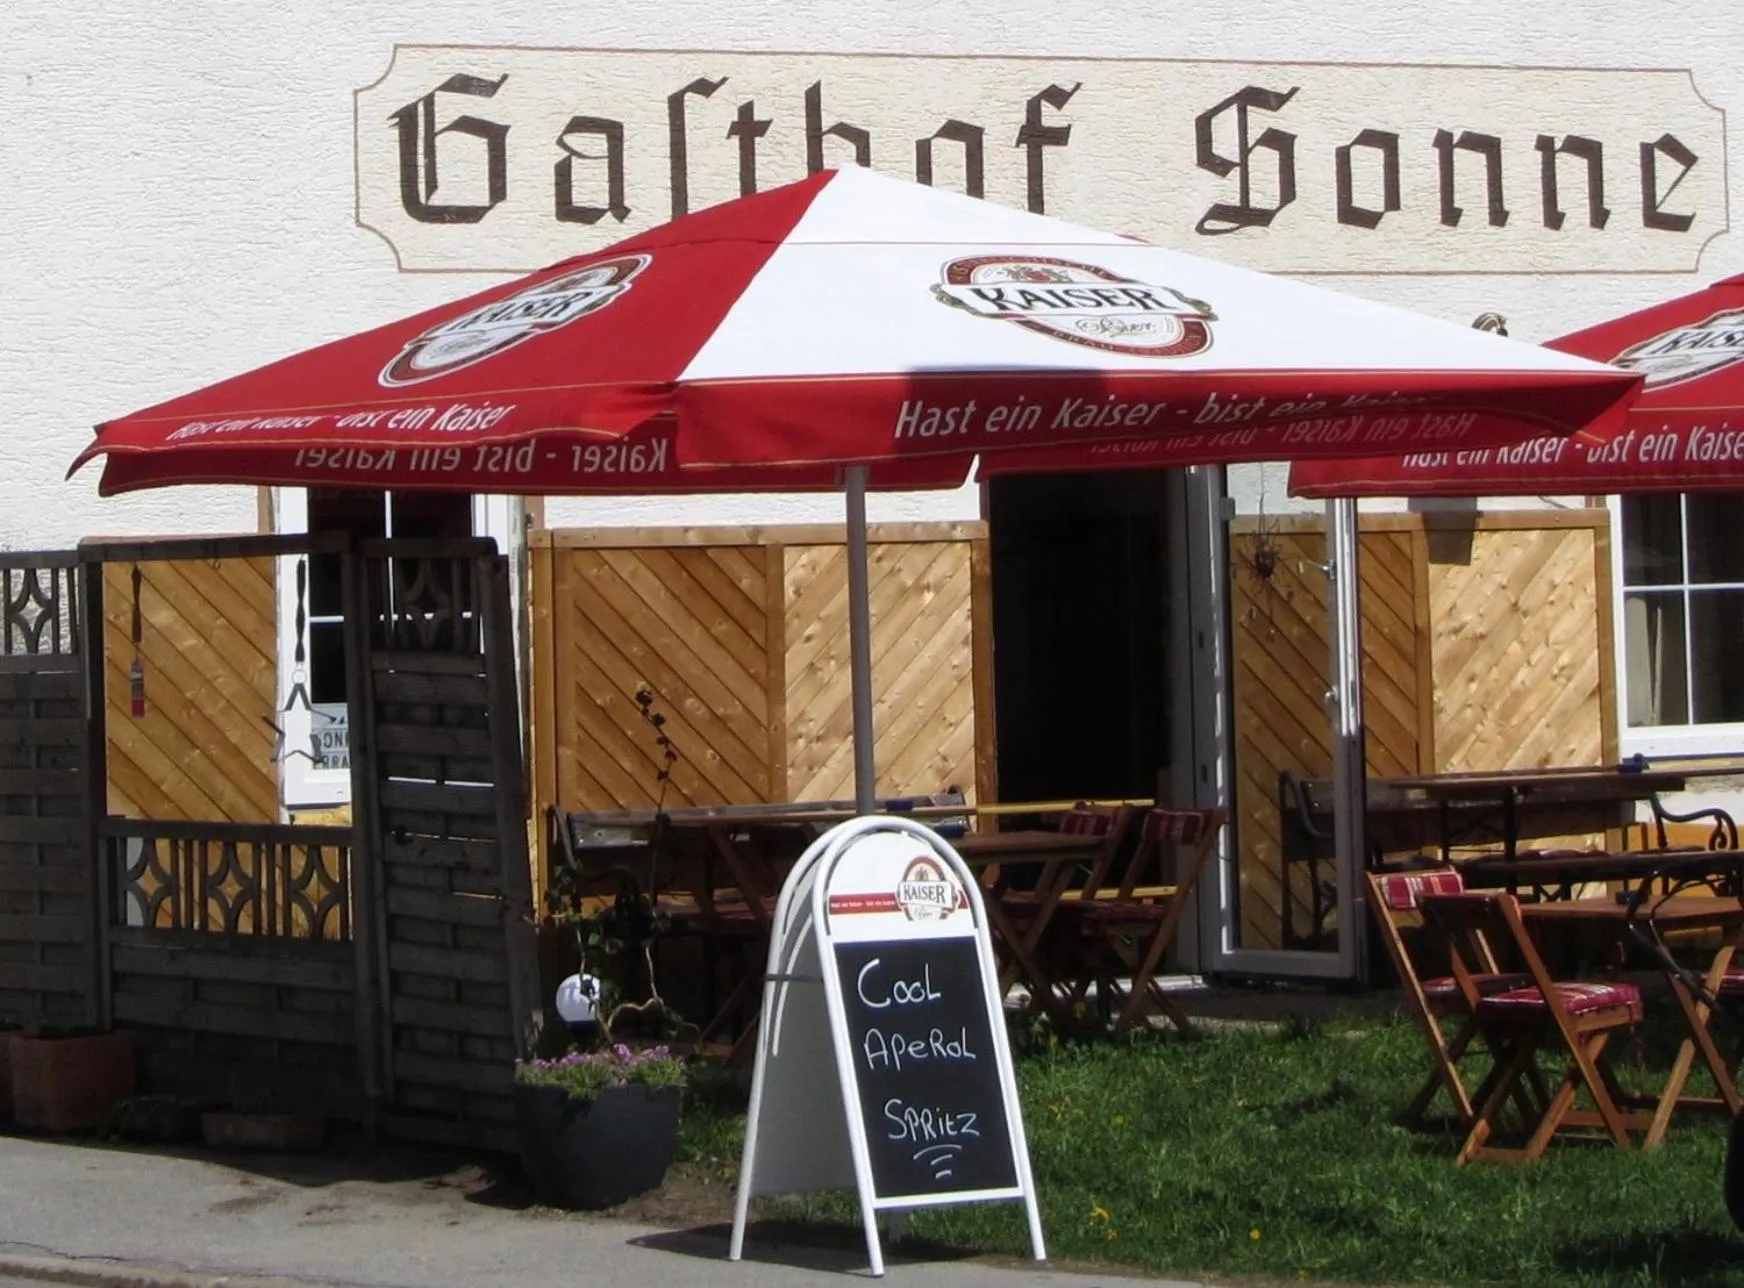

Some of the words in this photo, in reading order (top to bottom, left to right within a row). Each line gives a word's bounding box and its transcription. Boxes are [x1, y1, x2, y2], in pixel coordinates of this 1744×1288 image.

[1195, 85, 1699, 236] Sonne
[970, 286, 1180, 311] KAISER
[387, 404, 437, 430] ein
[428, 401, 516, 432] Kaiser
[894, 398, 978, 439] Hast
[985, 395, 1043, 433] ein
[1050, 394, 1166, 430] Kaiser
[1193, 392, 1267, 424] bist
[1639, 424, 1679, 462] ein
[1684, 422, 1744, 462] Kaise
[903, 883, 946, 904] KAISER
